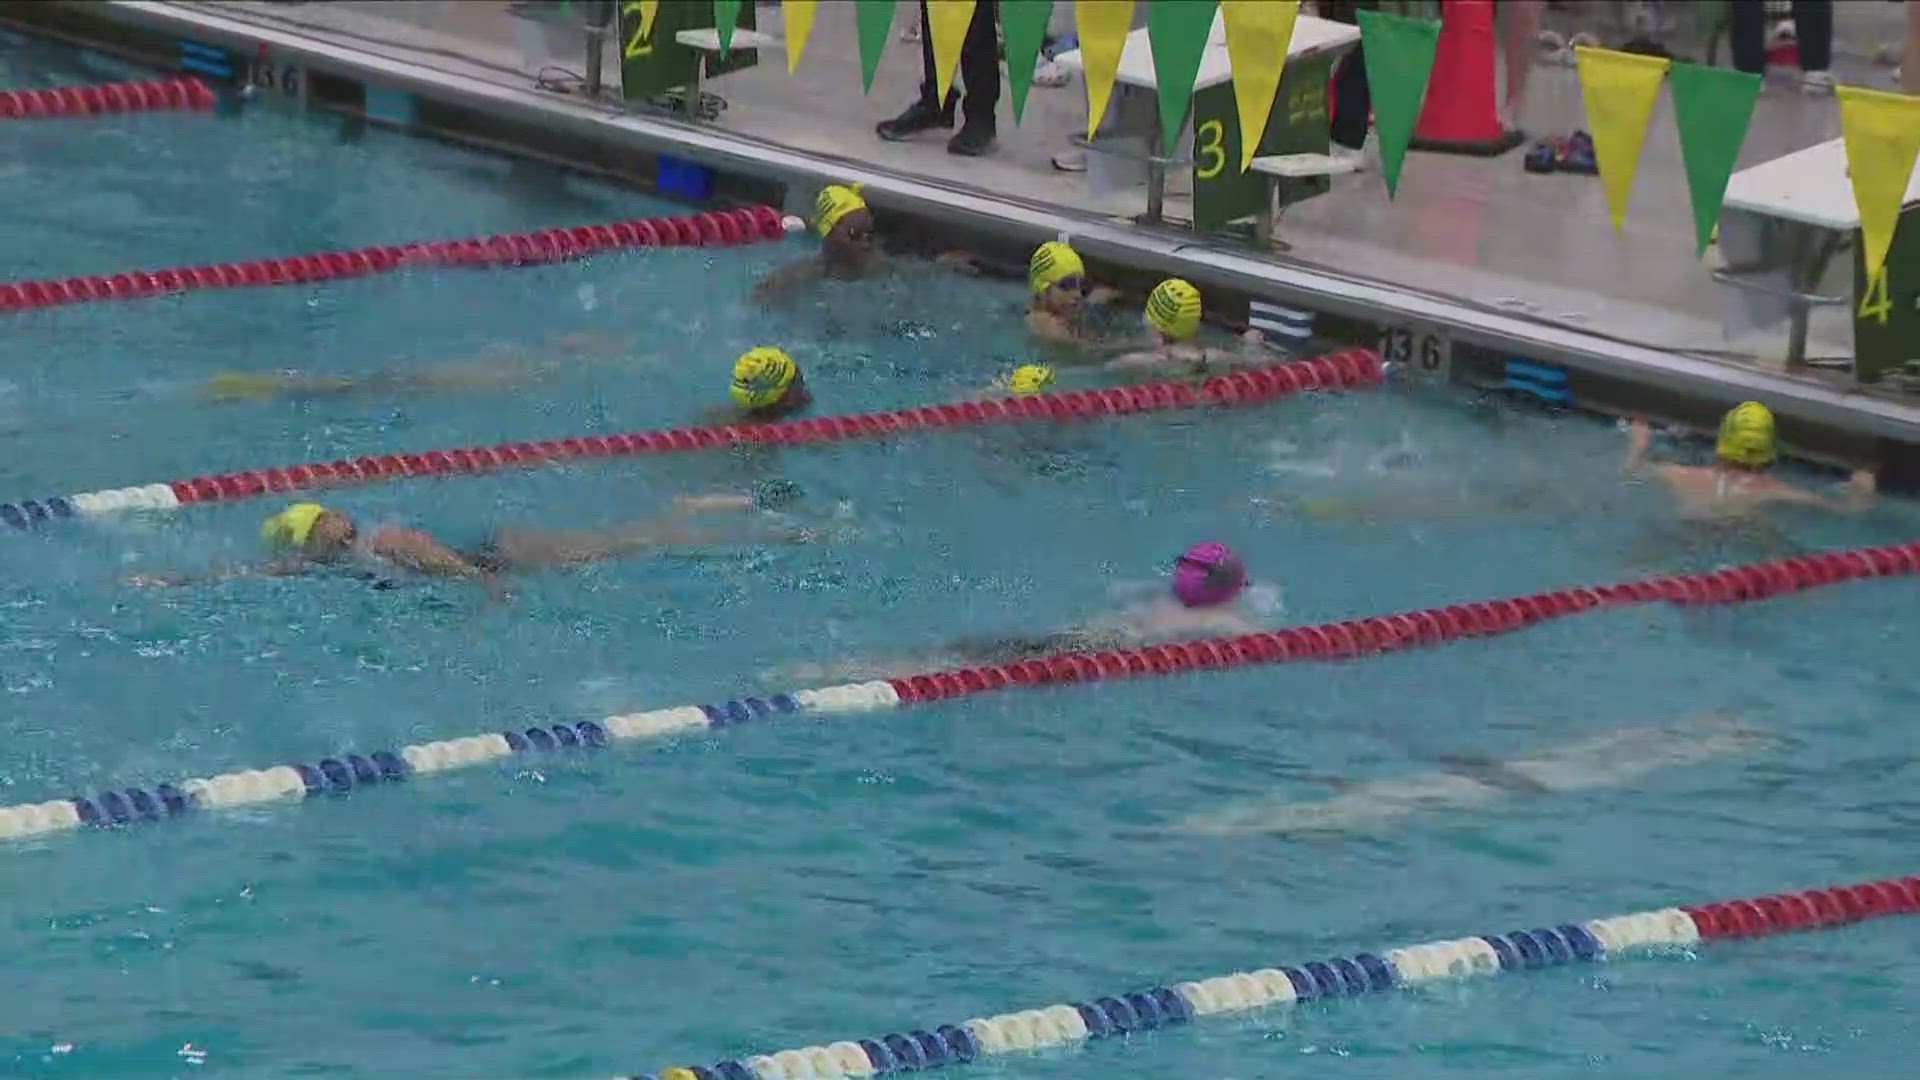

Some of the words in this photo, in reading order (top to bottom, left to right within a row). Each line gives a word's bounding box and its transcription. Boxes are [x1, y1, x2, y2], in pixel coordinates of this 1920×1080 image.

[623, 1, 653, 58] 2
[1197, 119, 1226, 180] 3
[1857, 263, 1893, 325] 4
[1380, 327, 1412, 362] 13
[1422, 334, 1440, 370] 6
